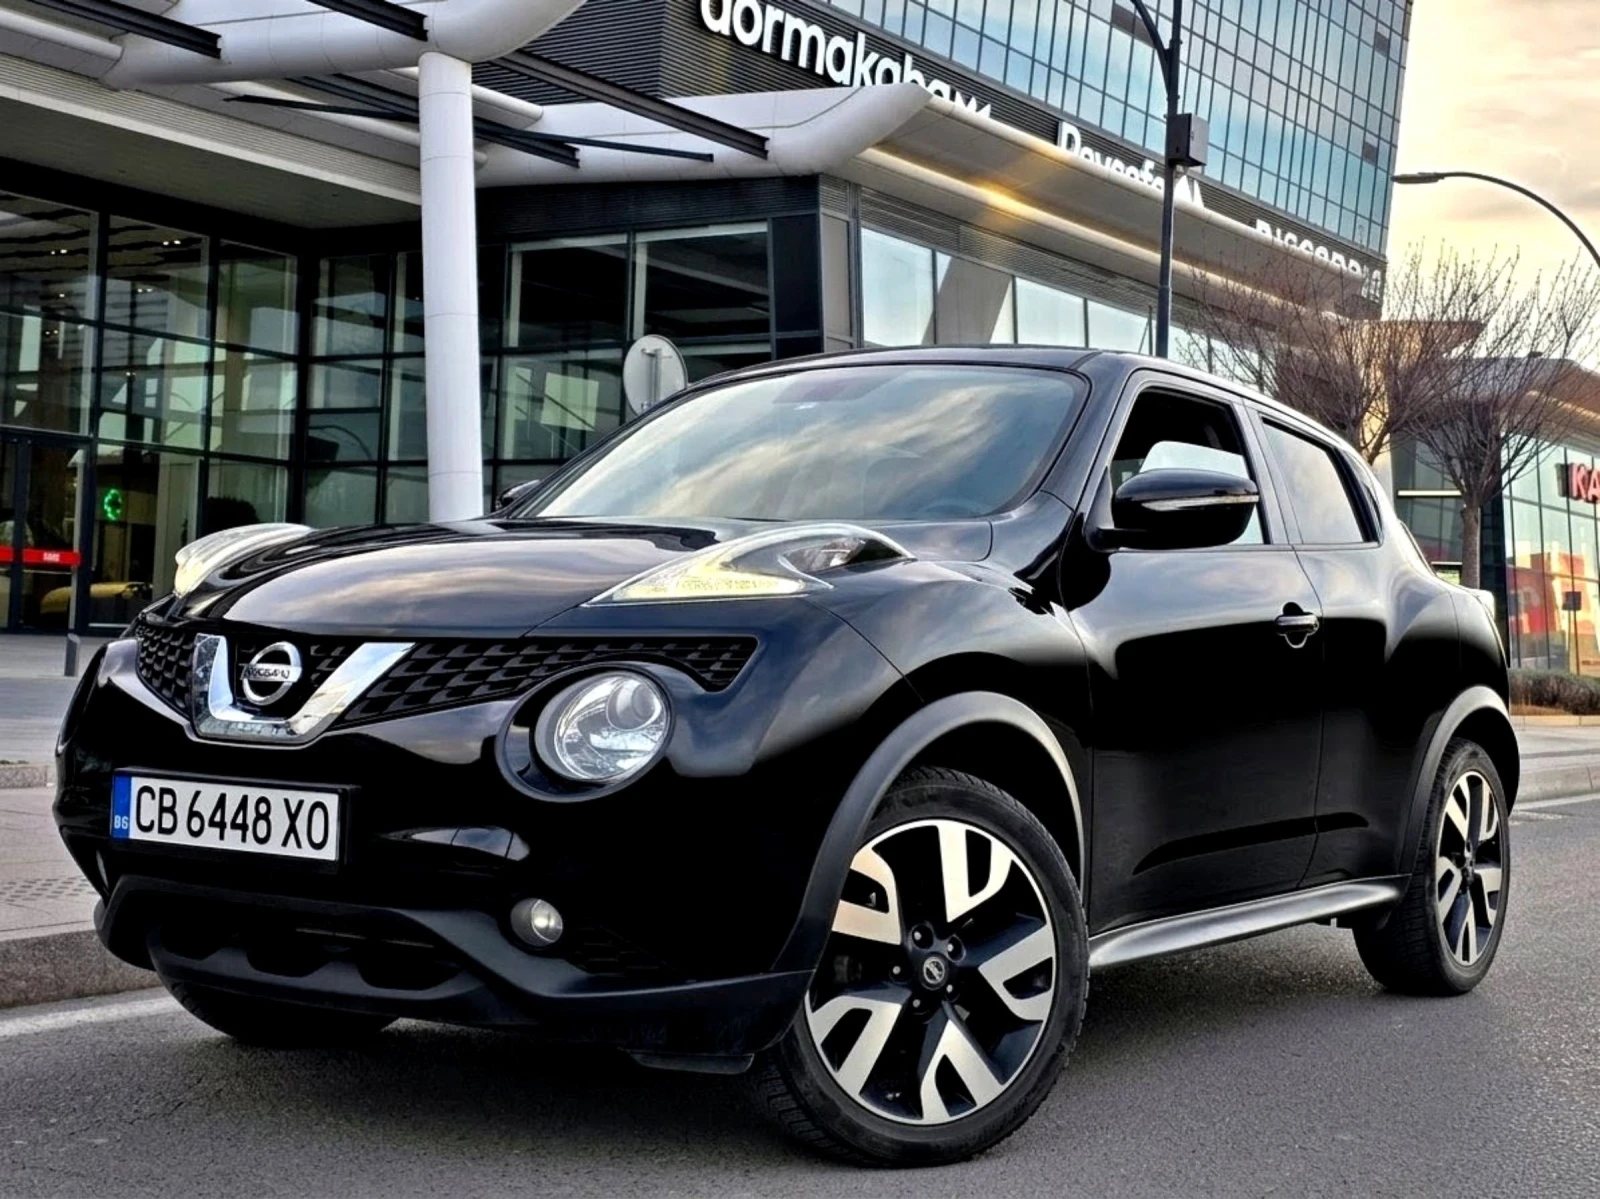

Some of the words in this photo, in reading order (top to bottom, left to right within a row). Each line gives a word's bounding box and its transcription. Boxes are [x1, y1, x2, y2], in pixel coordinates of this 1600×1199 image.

[135, 785, 178, 835] CB
[186, 790, 272, 845] 6448
[281, 797, 329, 850] XO
